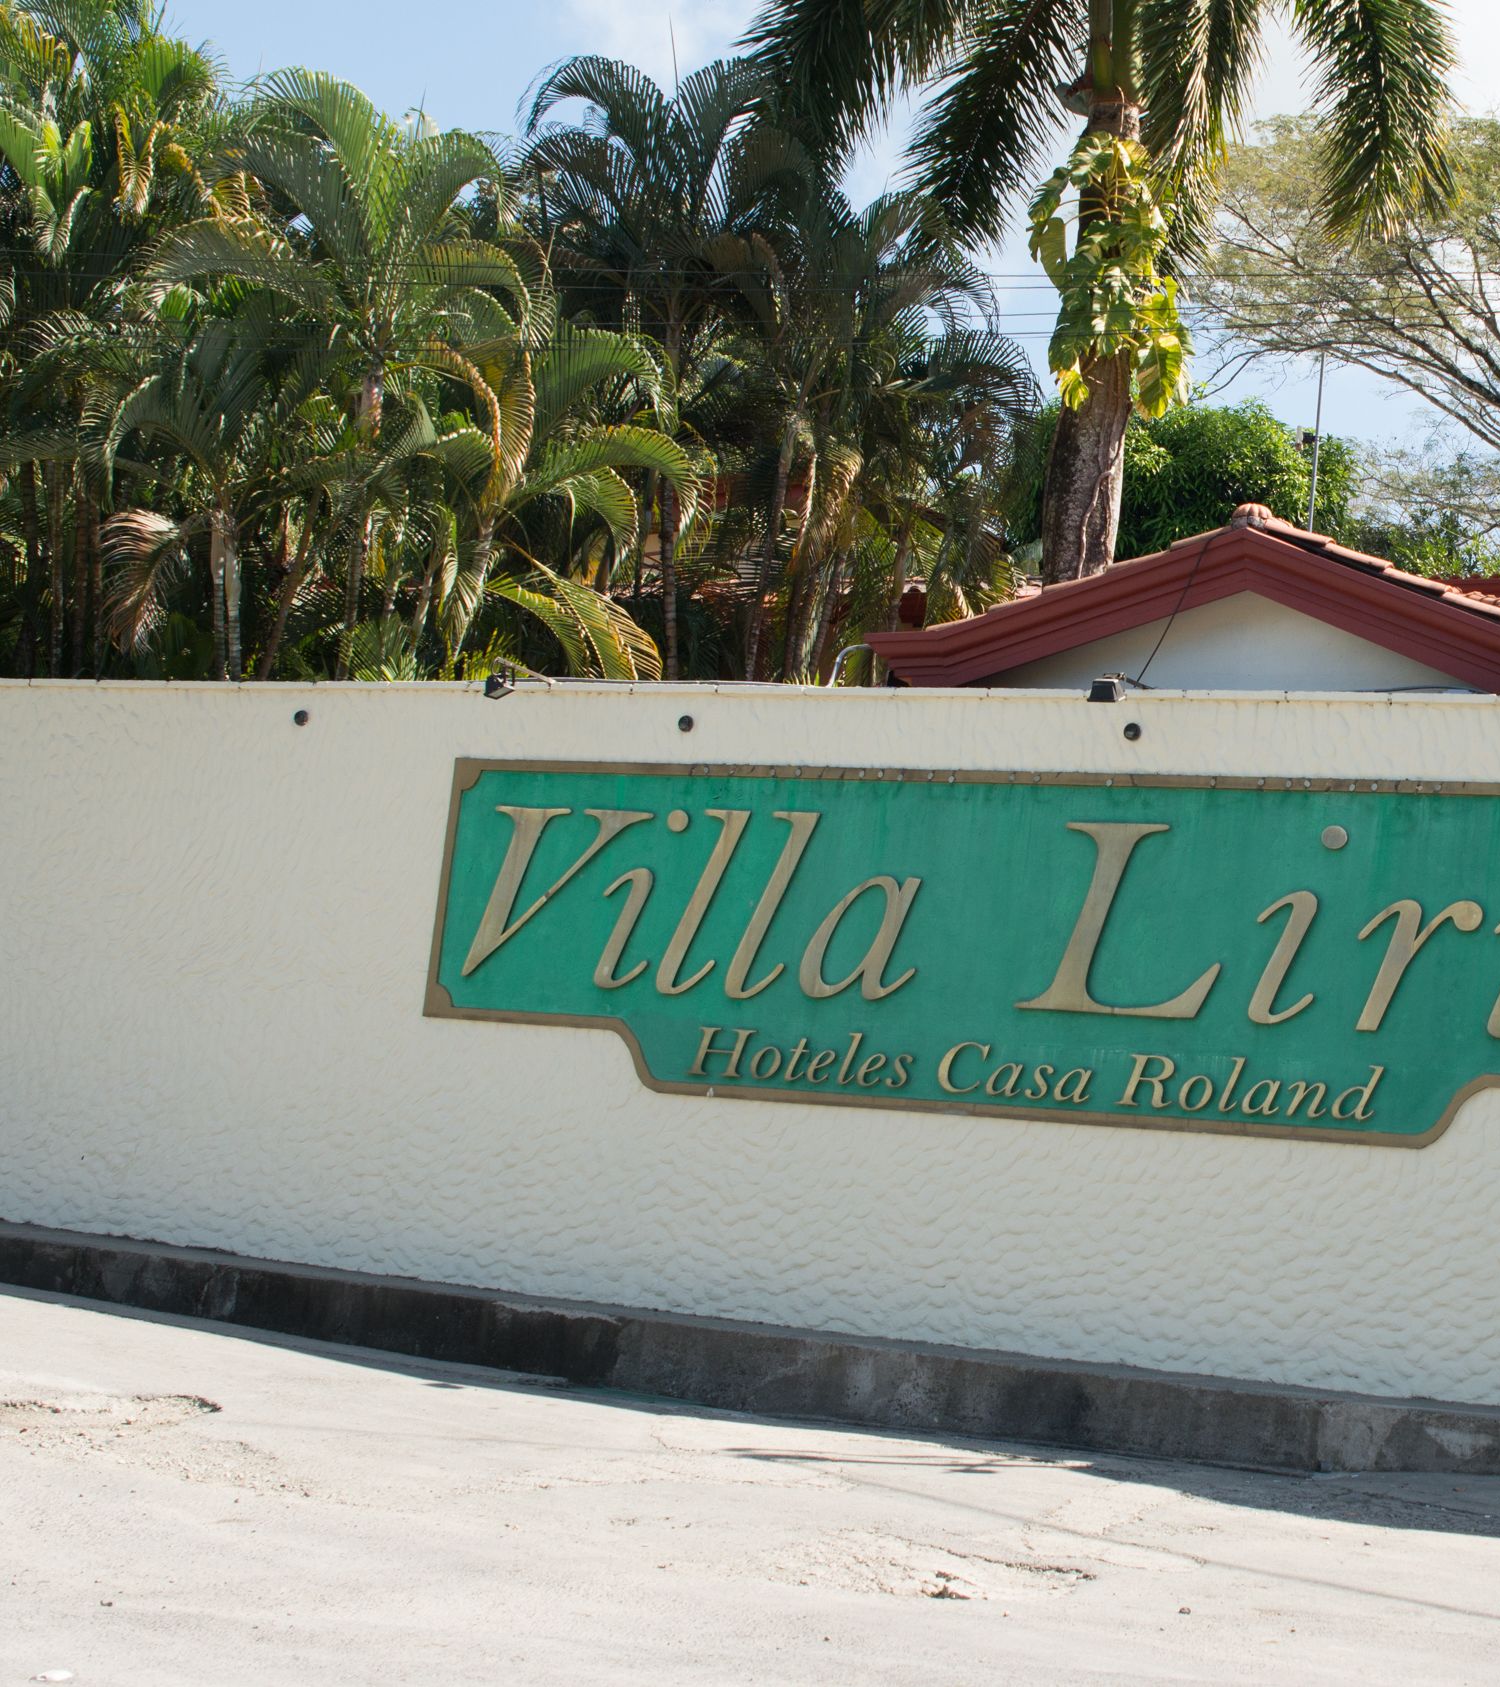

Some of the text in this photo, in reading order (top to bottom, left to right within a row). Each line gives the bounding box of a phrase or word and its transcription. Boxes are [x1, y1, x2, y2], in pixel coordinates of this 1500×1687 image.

[461, 805, 921, 1000] Villa
[687, 1025, 1386, 1123] Hoteles Casa Roland
